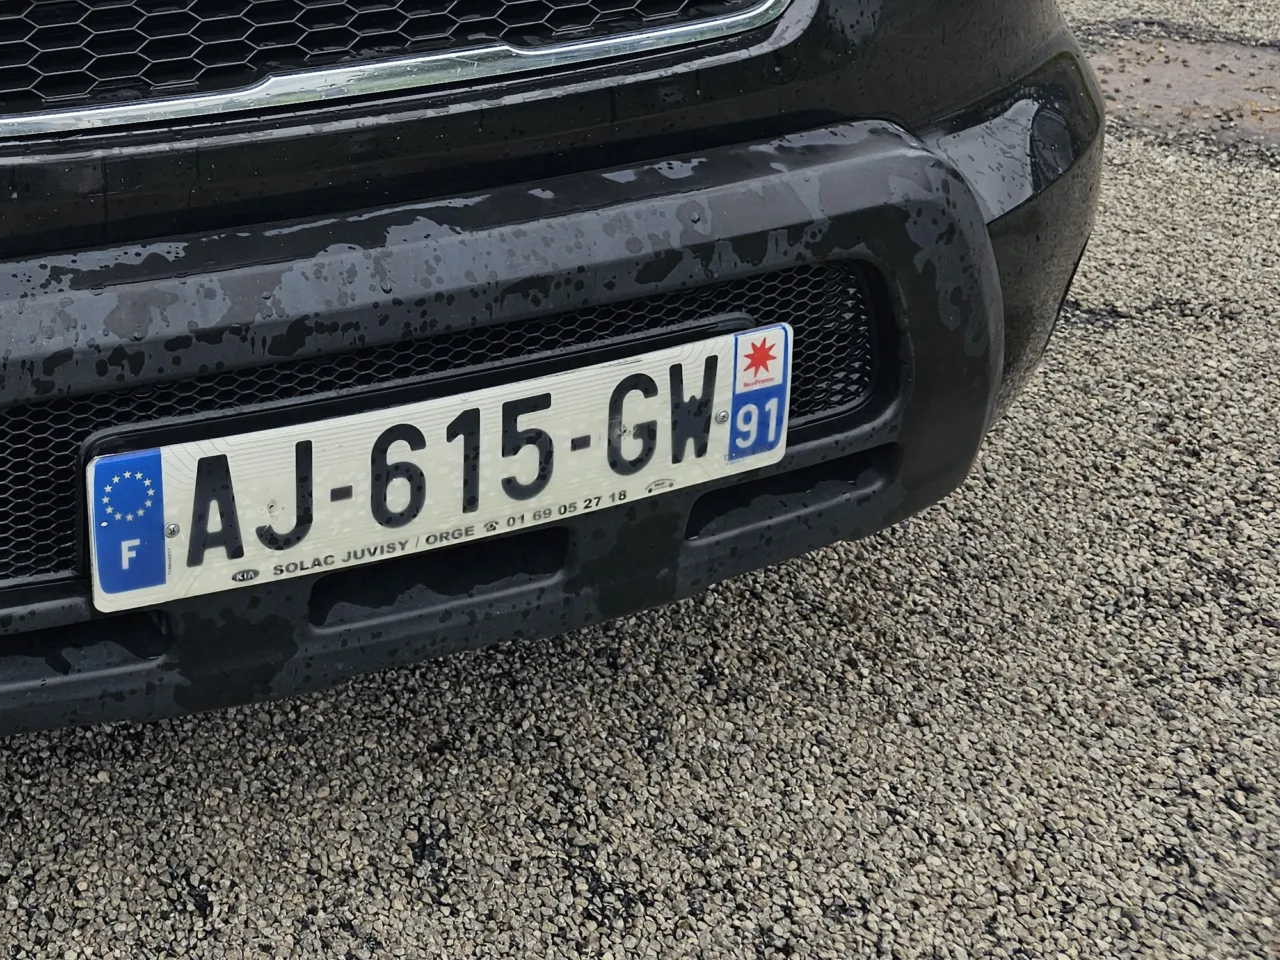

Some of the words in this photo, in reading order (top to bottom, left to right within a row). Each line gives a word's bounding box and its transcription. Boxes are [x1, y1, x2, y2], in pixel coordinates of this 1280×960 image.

[735, 397, 779, 448] 91
[186, 354, 719, 568] AJ-615-GW
[121, 539, 141, 570] F
[272, 554, 335, 576] SOLAC
[341, 539, 409, 563] JUVISY
[425, 525, 475, 545] ORGE
[506, 513, 525, 528] 01
[532, 508, 553, 522] 69
[557, 502, 578, 516] 05
[583, 496, 603, 510] 27
[608, 490, 627, 503] 18
[236, 571, 255, 581] KIA
